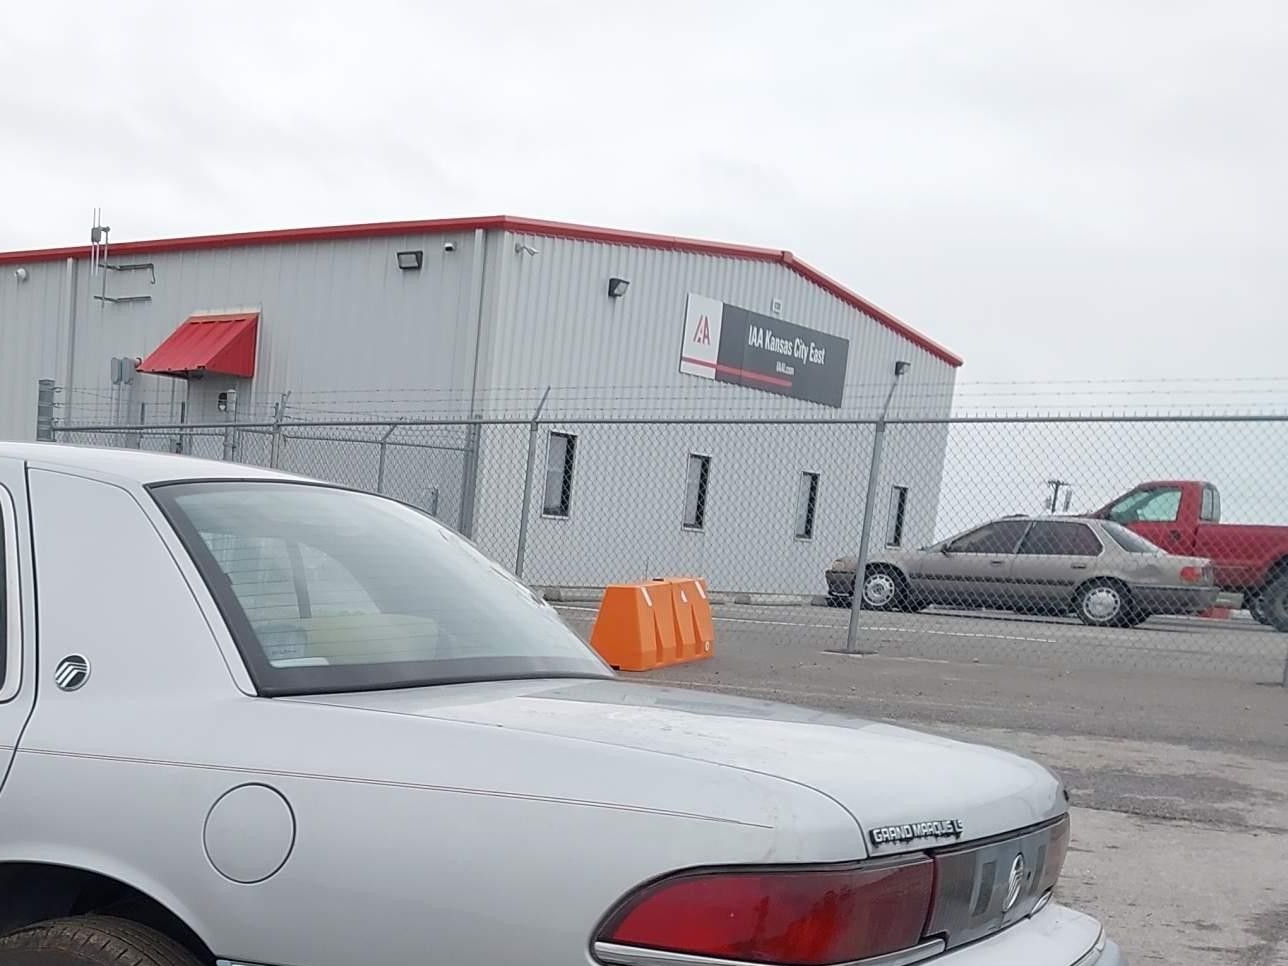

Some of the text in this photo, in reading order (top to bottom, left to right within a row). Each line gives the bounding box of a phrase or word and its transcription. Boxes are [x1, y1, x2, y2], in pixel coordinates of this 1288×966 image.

[748, 325, 826, 365] IAA Kansas City East
[873, 825, 912, 842] GRAND
[913, 820, 953, 836] MARQUIS
